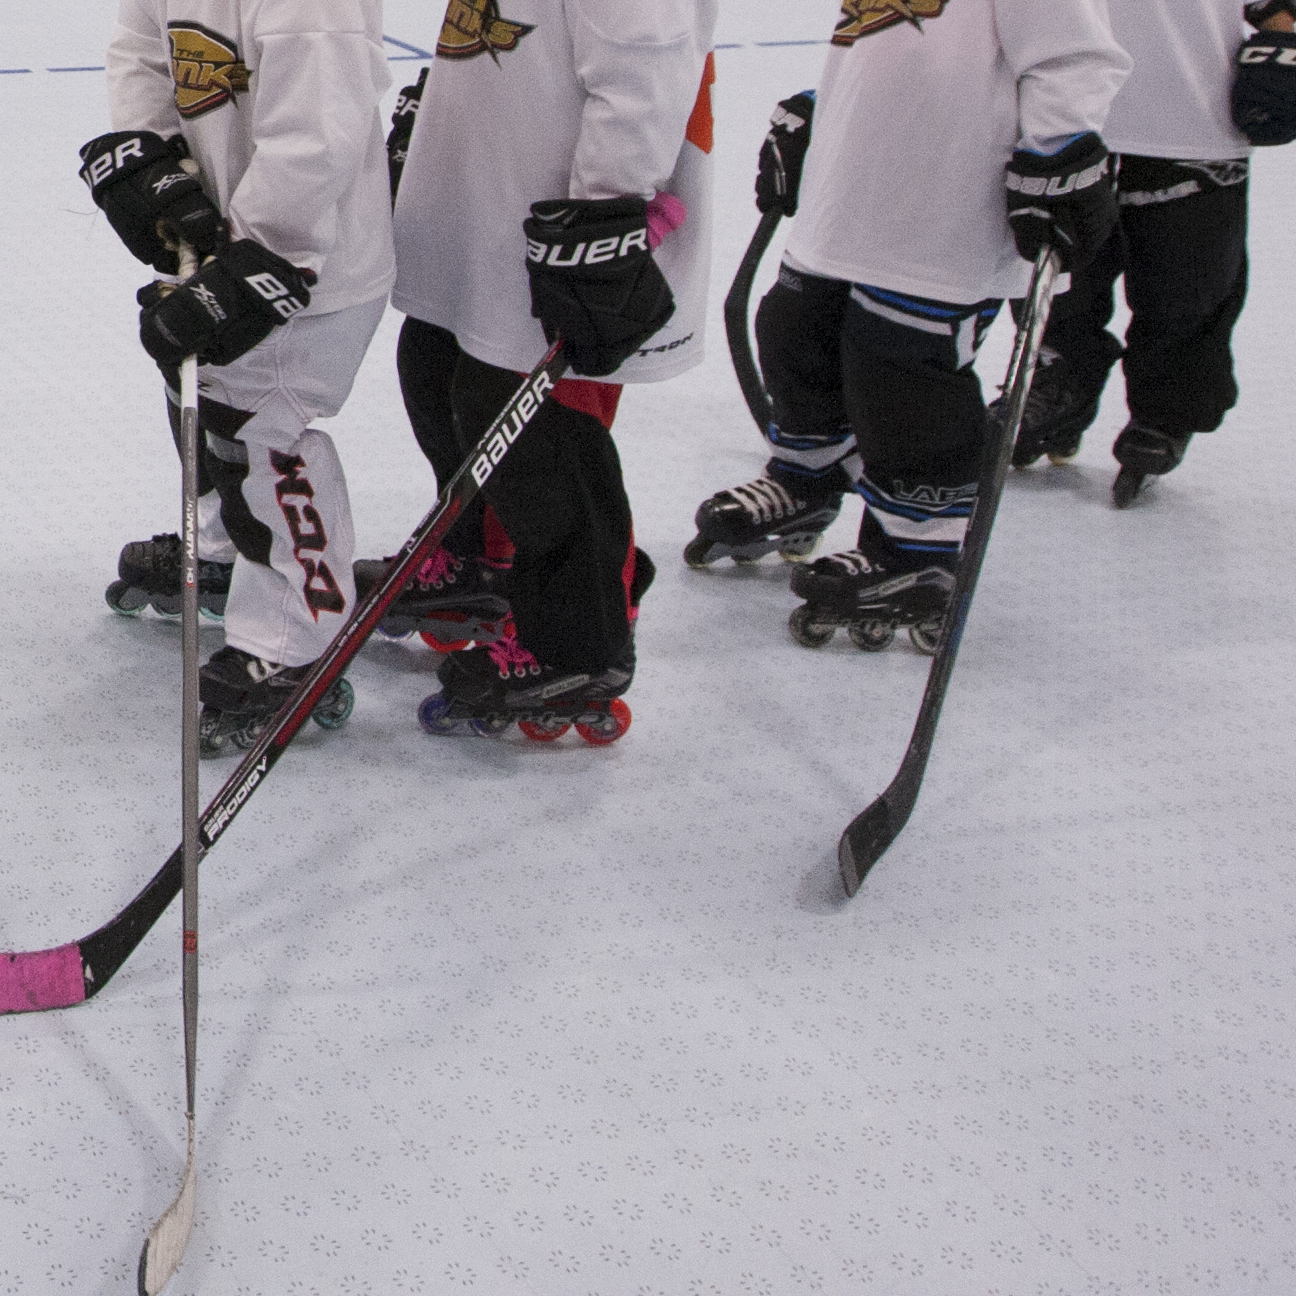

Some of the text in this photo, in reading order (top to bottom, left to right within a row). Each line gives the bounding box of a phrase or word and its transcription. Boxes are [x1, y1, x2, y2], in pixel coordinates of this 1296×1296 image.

[176, 48, 205, 59] THE
[527, 227, 649, 266] AUER
[471, 370, 555, 478] BAUER
[207, 755, 267, 842] PRODIGY
